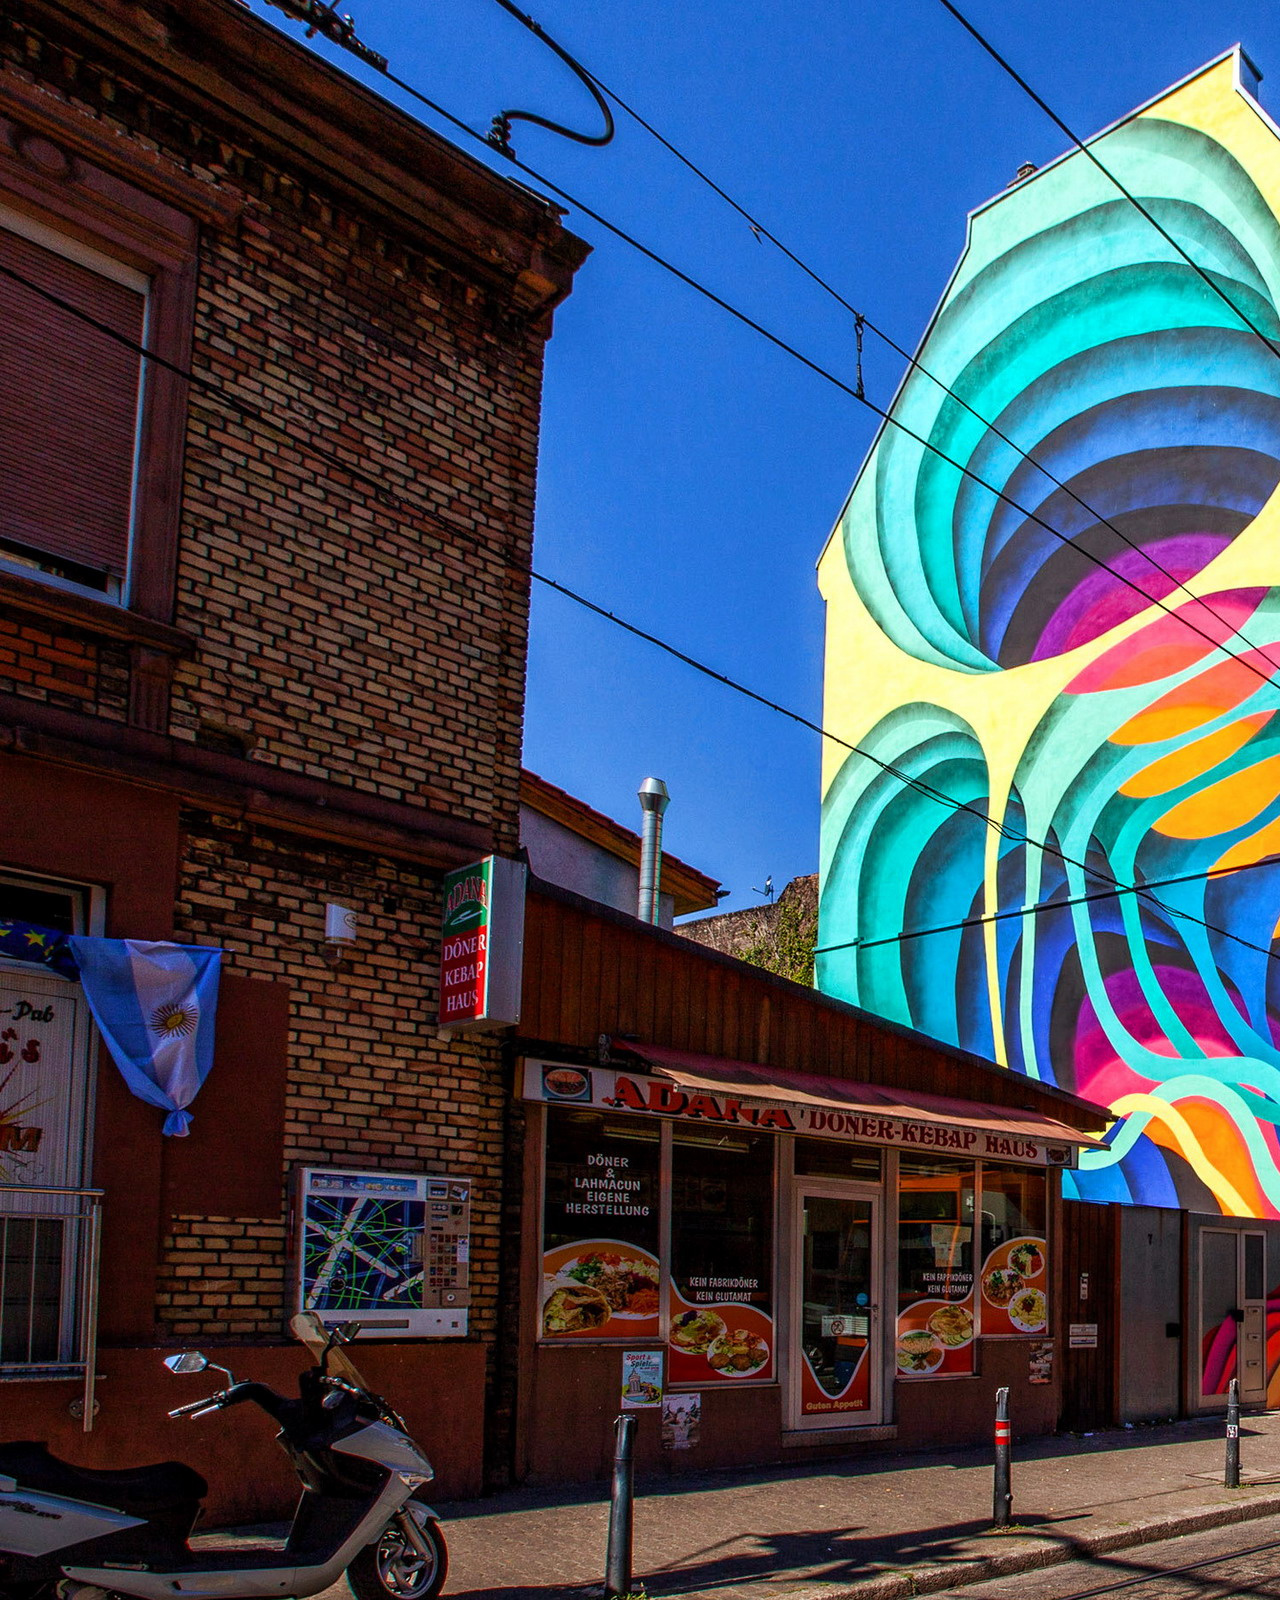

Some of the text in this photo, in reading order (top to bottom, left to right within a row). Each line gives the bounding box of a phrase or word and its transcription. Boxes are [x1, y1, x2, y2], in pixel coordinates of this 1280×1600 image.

[446, 875, 488, 912] ADANA
[444, 933, 486, 962] DÖNER
[444, 961, 484, 987] KEBAP
[446, 989, 478, 1012] HAUS
[602, 1076, 797, 1131] ADANA
[985, 1134, 1039, 1160] HAUS
[587, 1153, 629, 1168] DÖNER
[605, 1168, 615, 1179] &
[575, 1177, 641, 1191] LAHMACUN
[587, 1191, 630, 1203] EIGENE
[566, 1203, 650, 1217] HERSTELLUNG
[689, 1276, 759, 1288] KEIN FABRIKDÖNER
[922, 1272, 936, 1281] KEIN
[928, 1284, 969, 1294] KEIN GLUTAMAT
[696, 1291, 752, 1302] KEIN GLUTAMAT
[625, 1353, 646, 1361] Sport
[805, 1399, 863, 1411] Guten Appetit
